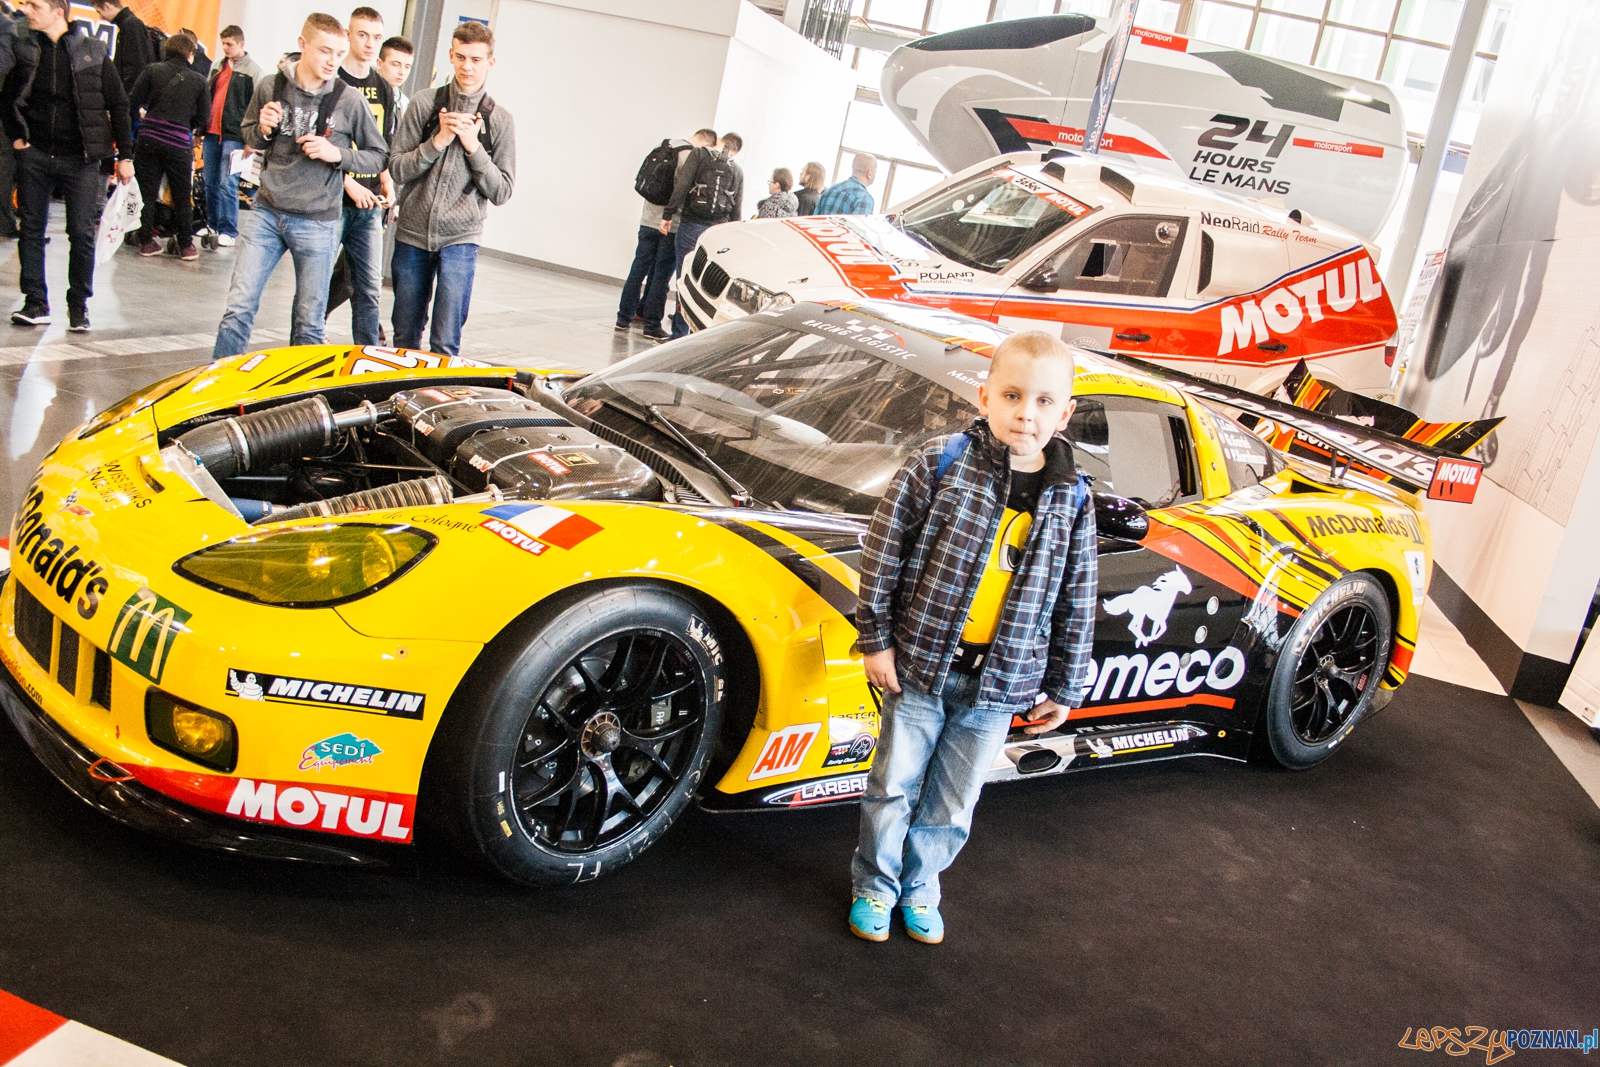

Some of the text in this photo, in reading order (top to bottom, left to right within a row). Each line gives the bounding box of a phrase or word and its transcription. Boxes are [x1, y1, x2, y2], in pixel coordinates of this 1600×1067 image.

[1134, 28, 1173, 43] motorsport
[1197, 113, 1296, 159] 24
[1314, 140, 1353, 153] motorsport
[1192, 150, 1276, 174] HOURS
[1188, 166, 1291, 195] LE MANS
[1045, 192, 1087, 216] MOTUL
[1200, 211, 1317, 244] NeoRaid Rally Team
[920, 271, 975, 281] POLAND
[1217, 256, 1383, 356] MOTUL
[802, 319, 917, 361] RACING LOGISTIC
[530, 452, 568, 474] MOTUL
[1436, 461, 1478, 486] MOTUL
[411, 514, 478, 533] Cologne
[1306, 514, 1409, 538] McDonald's
[483, 519, 547, 555] MOTUL
[267, 677, 423, 712] MICHELIN
[1111, 727, 1190, 750] MICHELIN
[753, 731, 815, 774] AM
[225, 777, 410, 839] MOTUL
